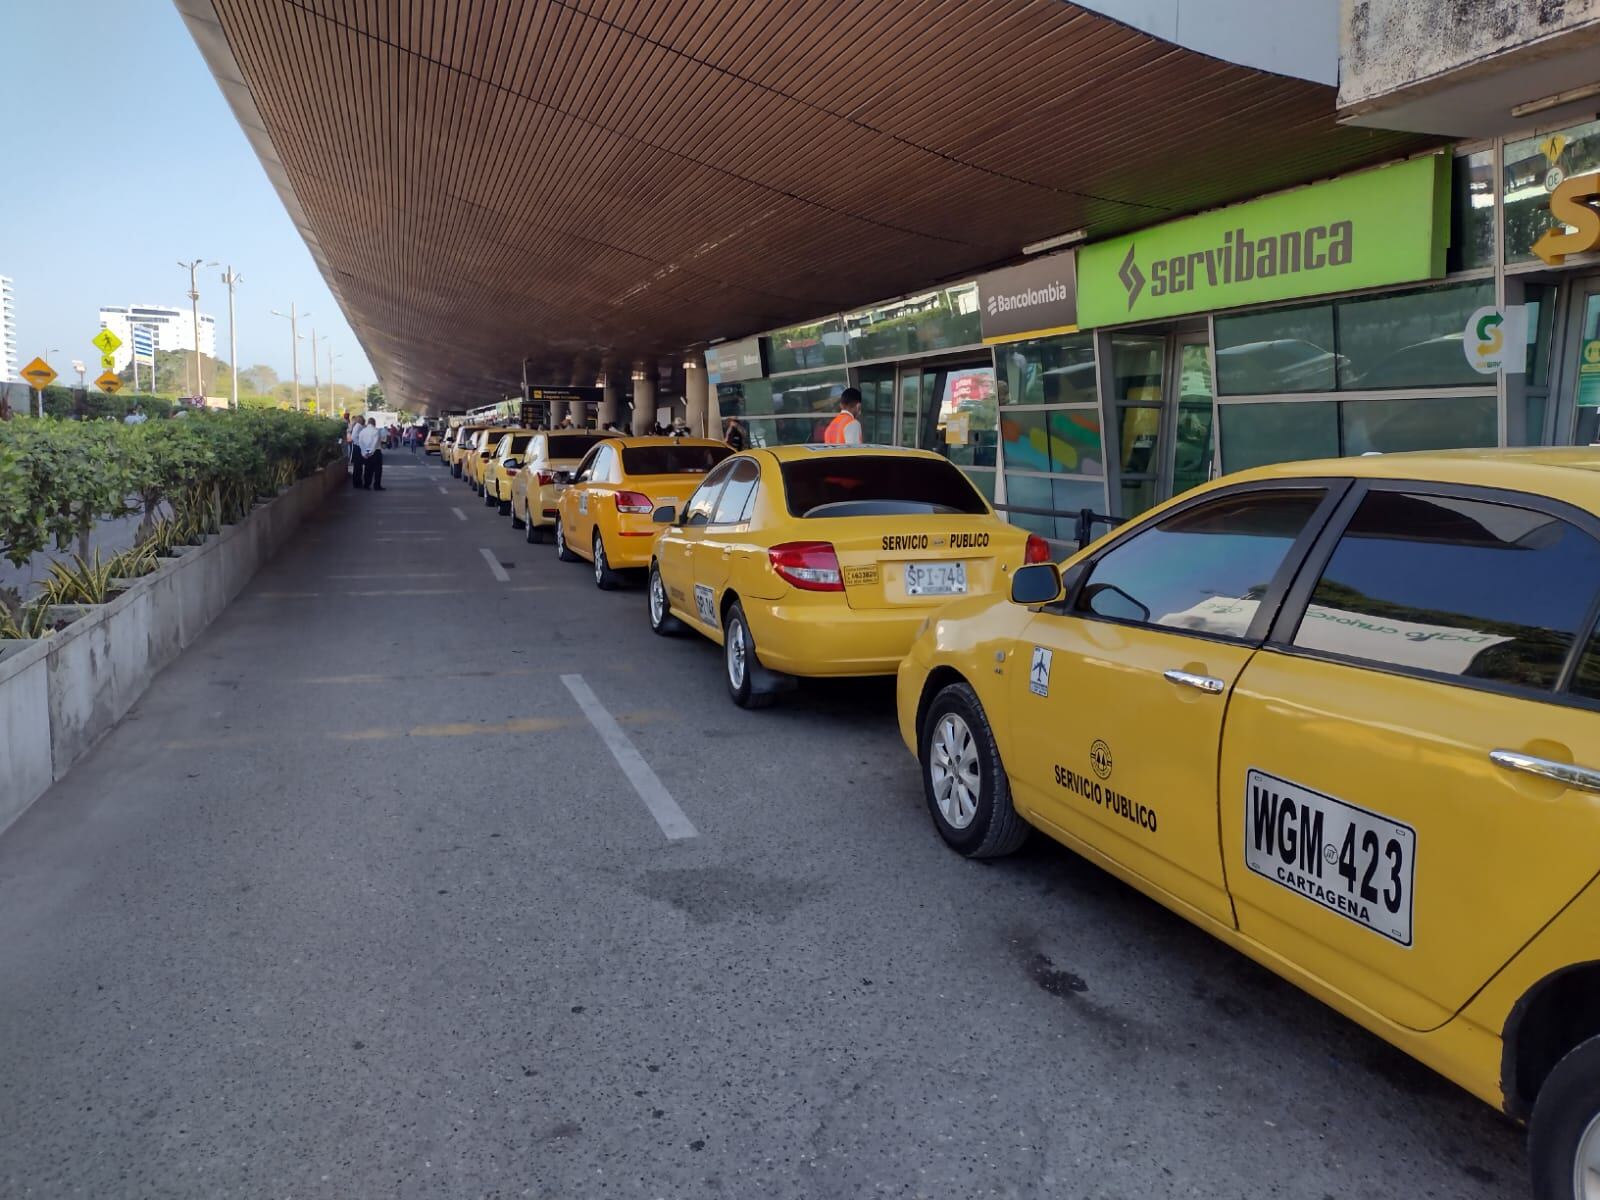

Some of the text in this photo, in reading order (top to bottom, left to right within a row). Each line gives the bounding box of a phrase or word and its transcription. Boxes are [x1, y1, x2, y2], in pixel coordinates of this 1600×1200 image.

[1150, 220, 1353, 297] servibanca
[997, 281, 1067, 313] Bancolombia
[882, 532, 990, 550] SERVICIO PUBLICO
[1054, 764, 1157, 833] SERVICIO PUBLICO
[1253, 785, 1324, 879] WGM
[1338, 821, 1403, 914] 423
[1277, 867, 1370, 922] CARTAGENA
